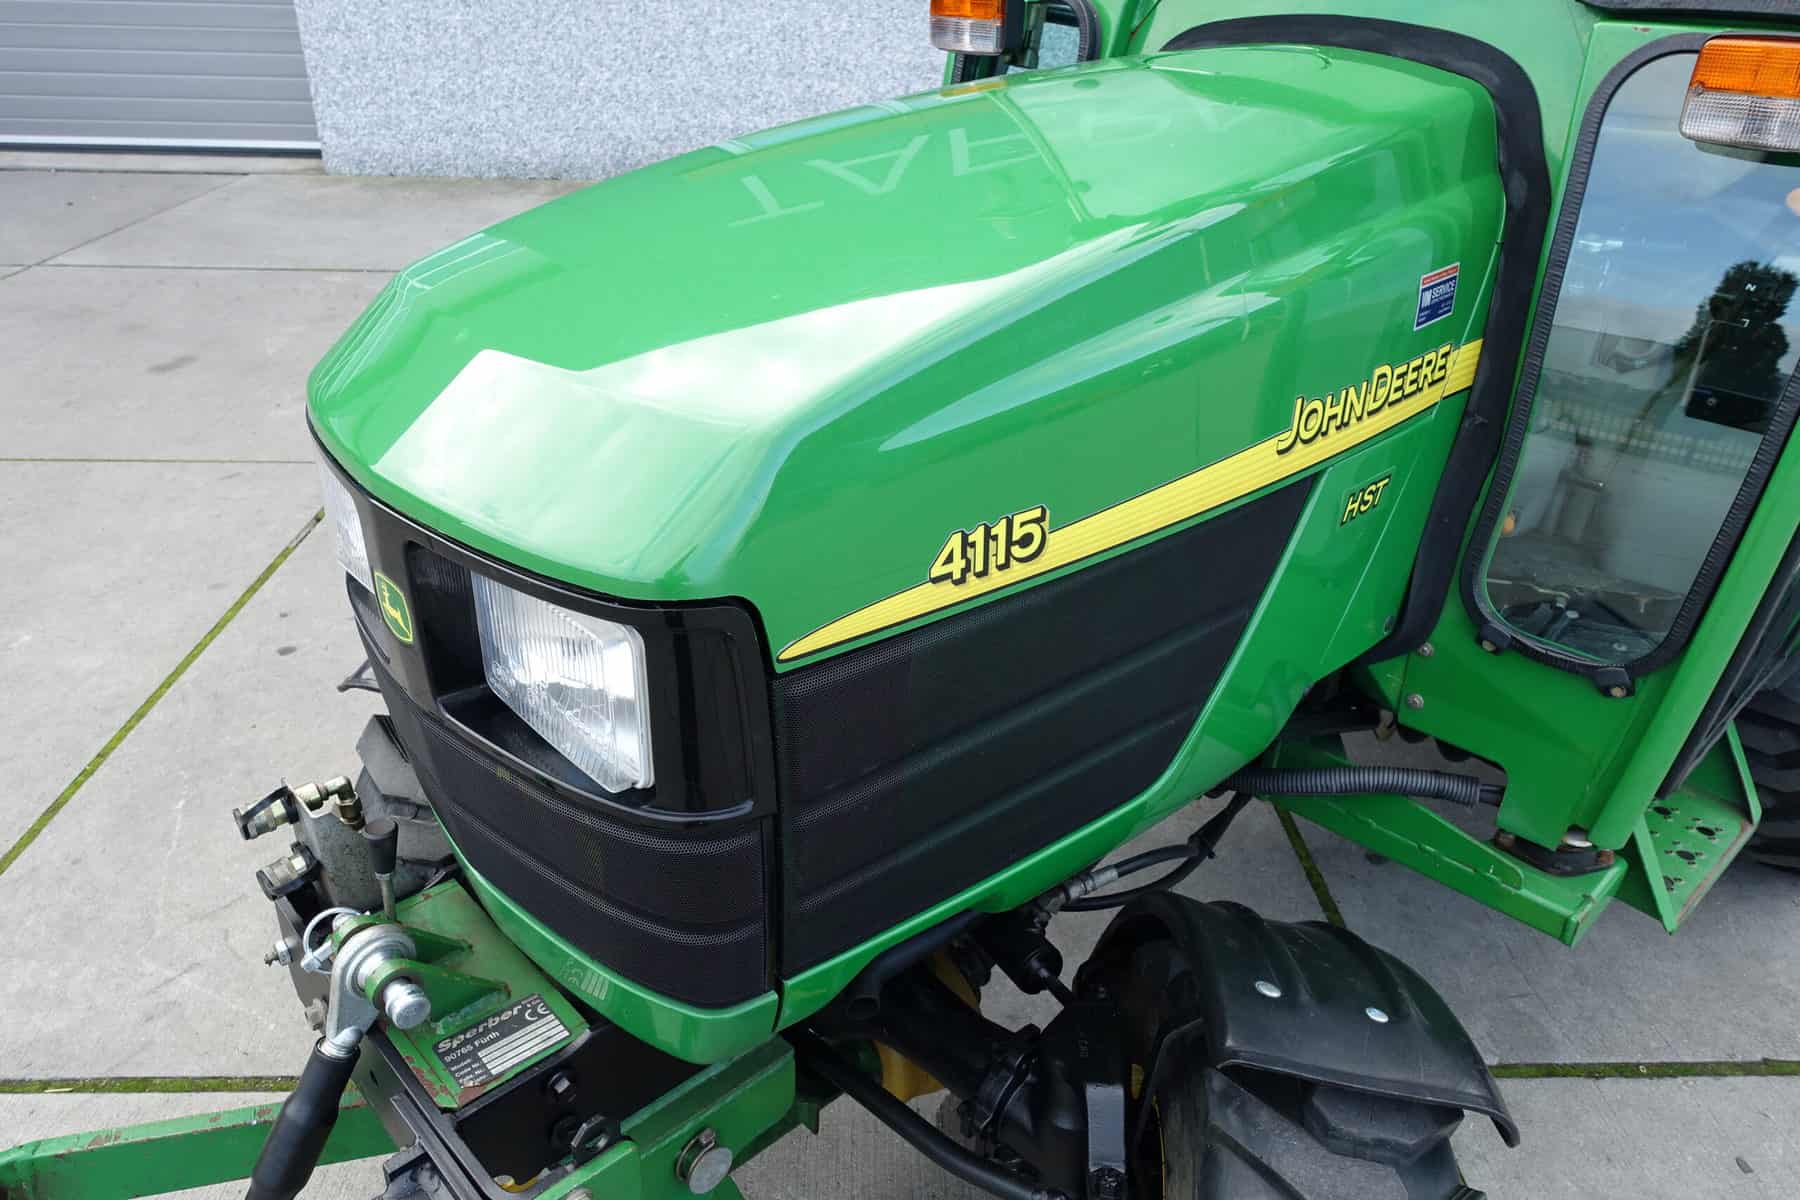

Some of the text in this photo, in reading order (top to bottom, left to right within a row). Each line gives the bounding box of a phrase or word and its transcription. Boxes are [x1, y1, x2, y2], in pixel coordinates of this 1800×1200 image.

[1276, 343, 1453, 455] JOHN DEERE
[1340, 474, 1392, 526] HST
[928, 504, 1050, 586] 4115
[437, 1004, 522, 1053] Sperber
[474, 1031, 500, 1048] Fürth
